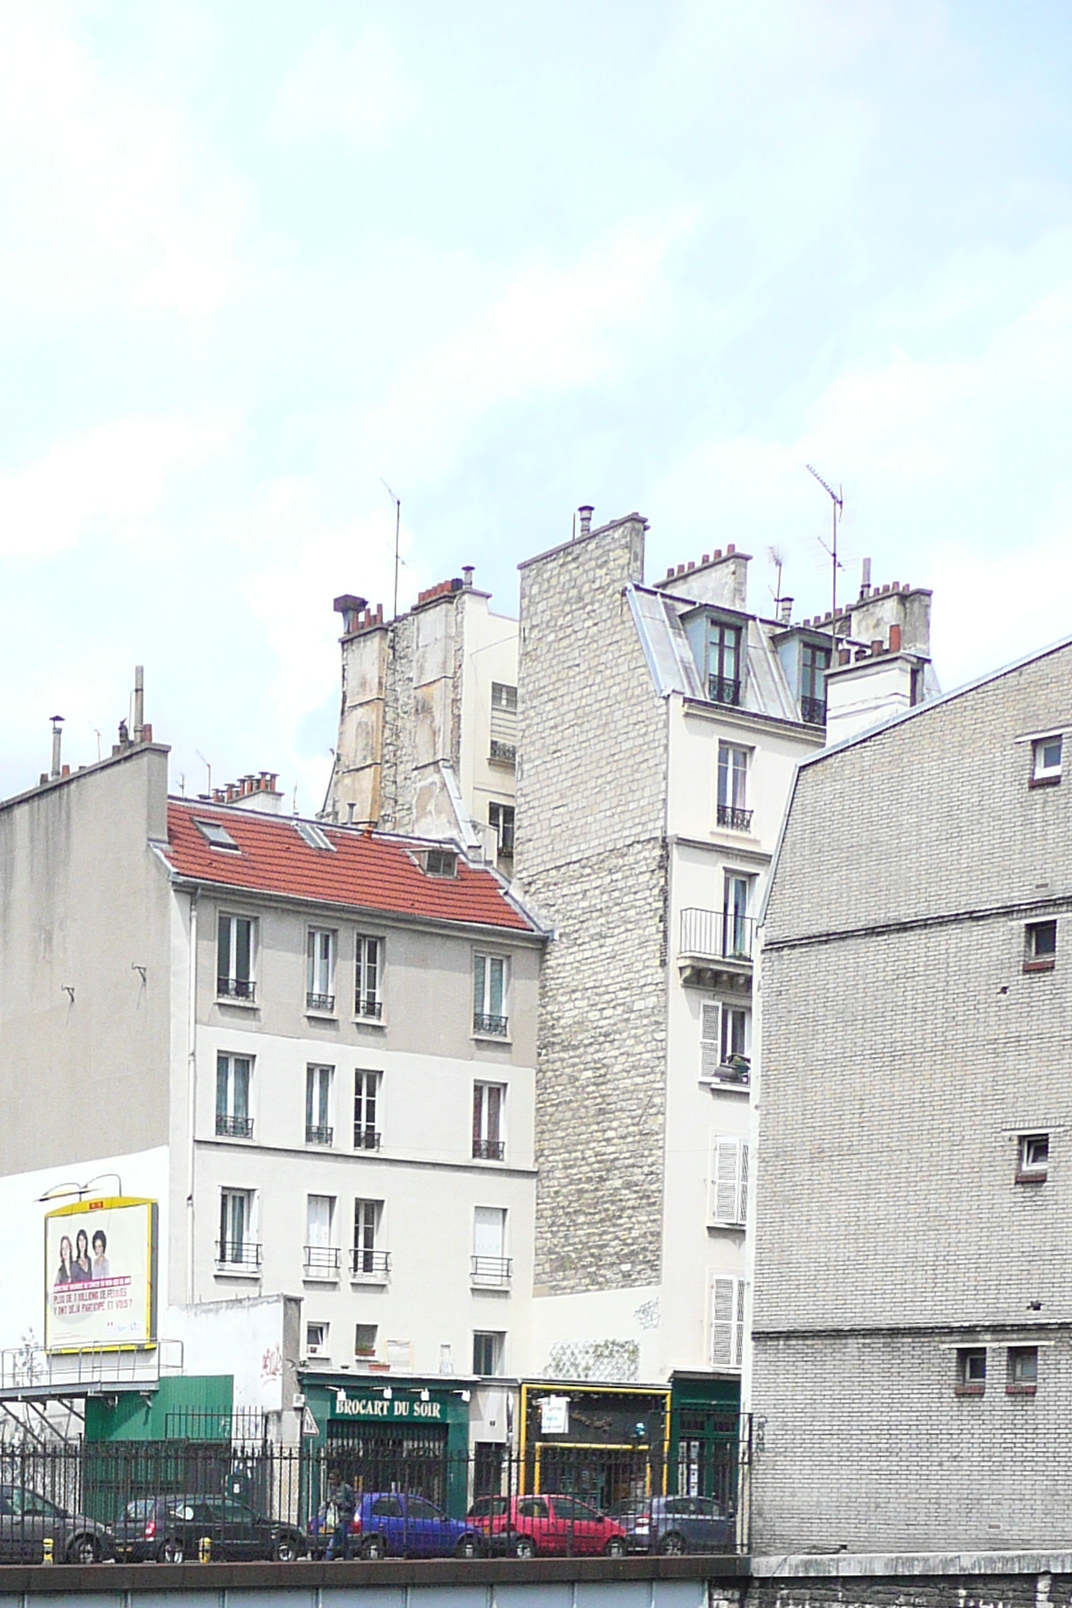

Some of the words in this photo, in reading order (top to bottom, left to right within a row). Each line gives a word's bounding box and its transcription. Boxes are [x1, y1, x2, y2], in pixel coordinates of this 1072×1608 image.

[335, 1399, 390, 1417] BROCART
[393, 1400, 410, 1417] DU
[413, 1401, 441, 1419] SOIR
